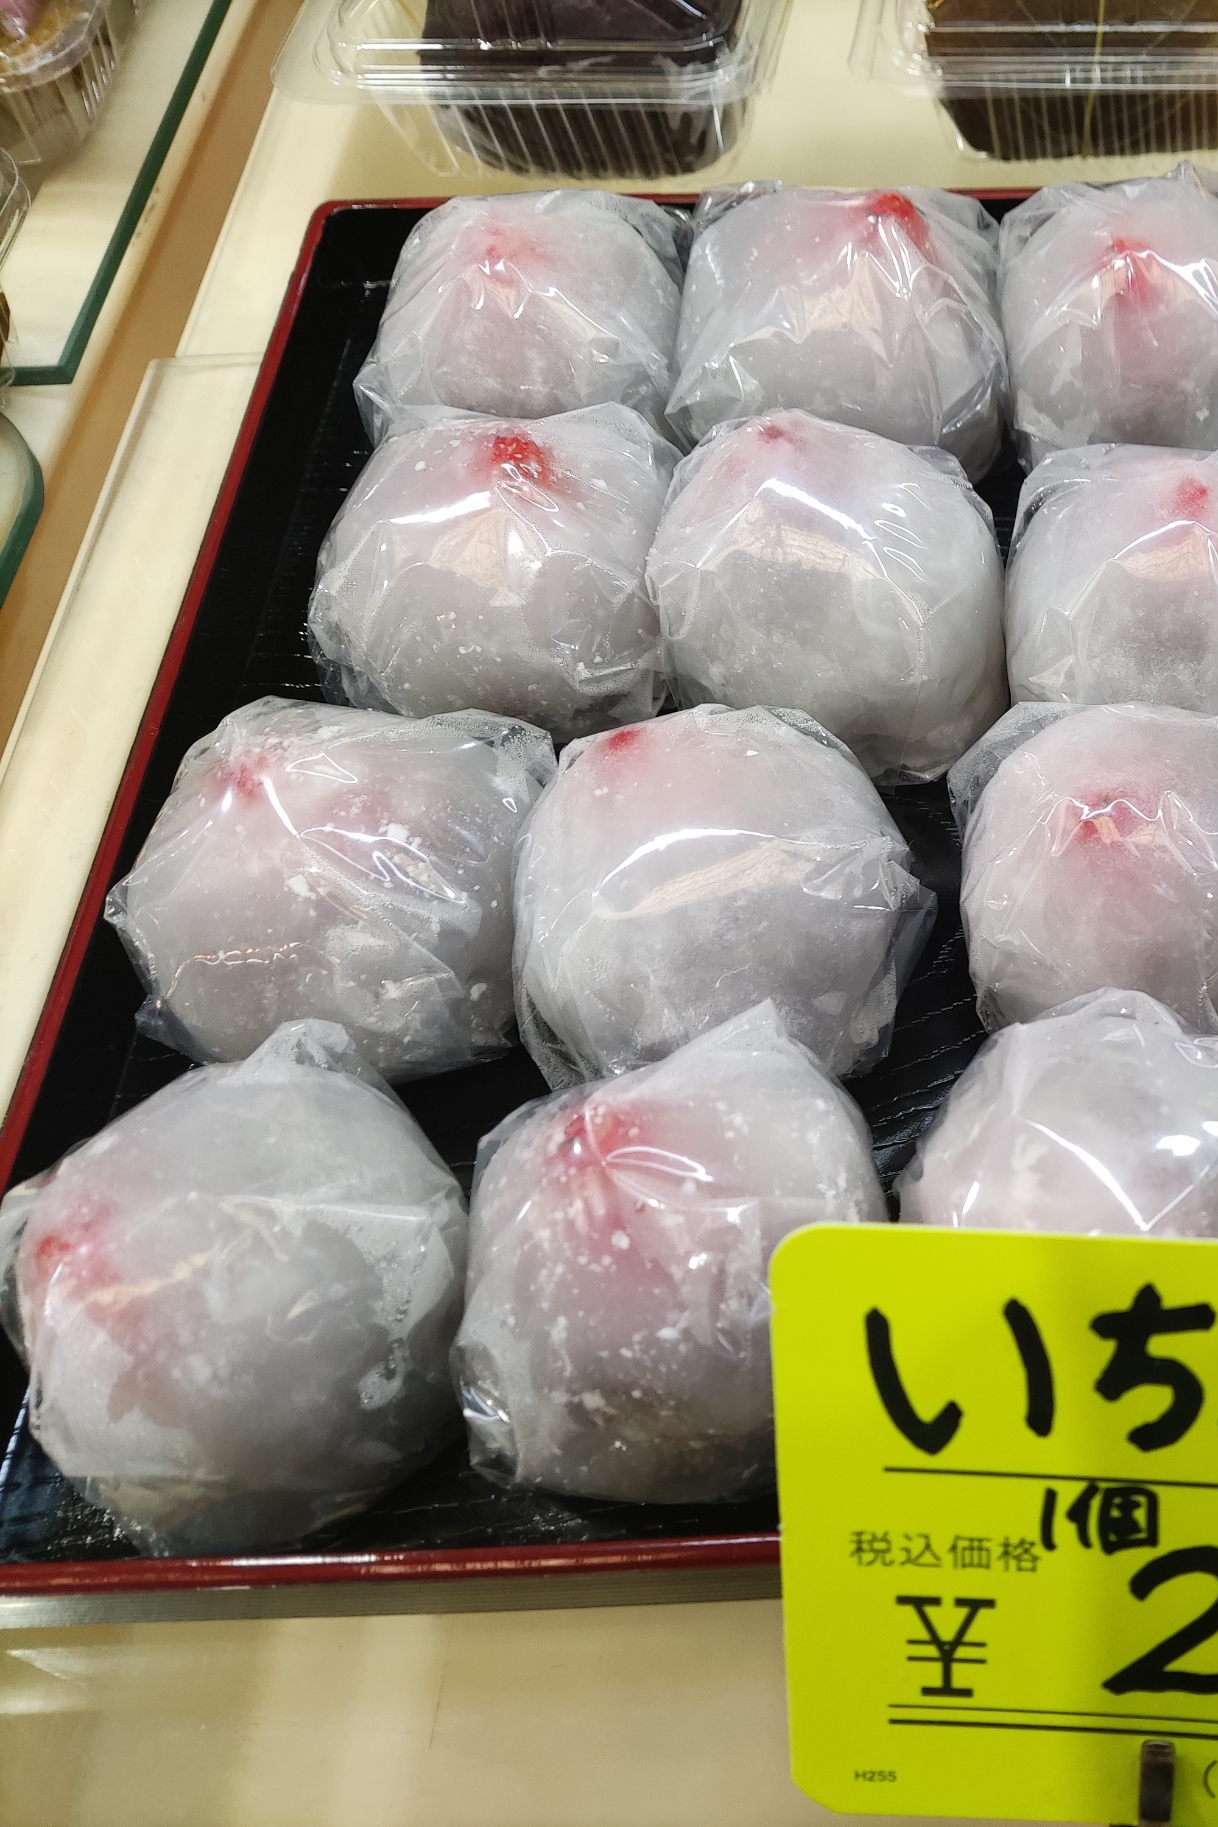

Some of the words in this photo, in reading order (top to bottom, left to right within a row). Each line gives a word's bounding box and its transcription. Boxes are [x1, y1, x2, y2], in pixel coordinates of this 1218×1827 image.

[849, 1529, 1041, 1573] 税込価格
[895, 1594, 997, 1699] ¥
[853, 1769, 898, 1783] H255
